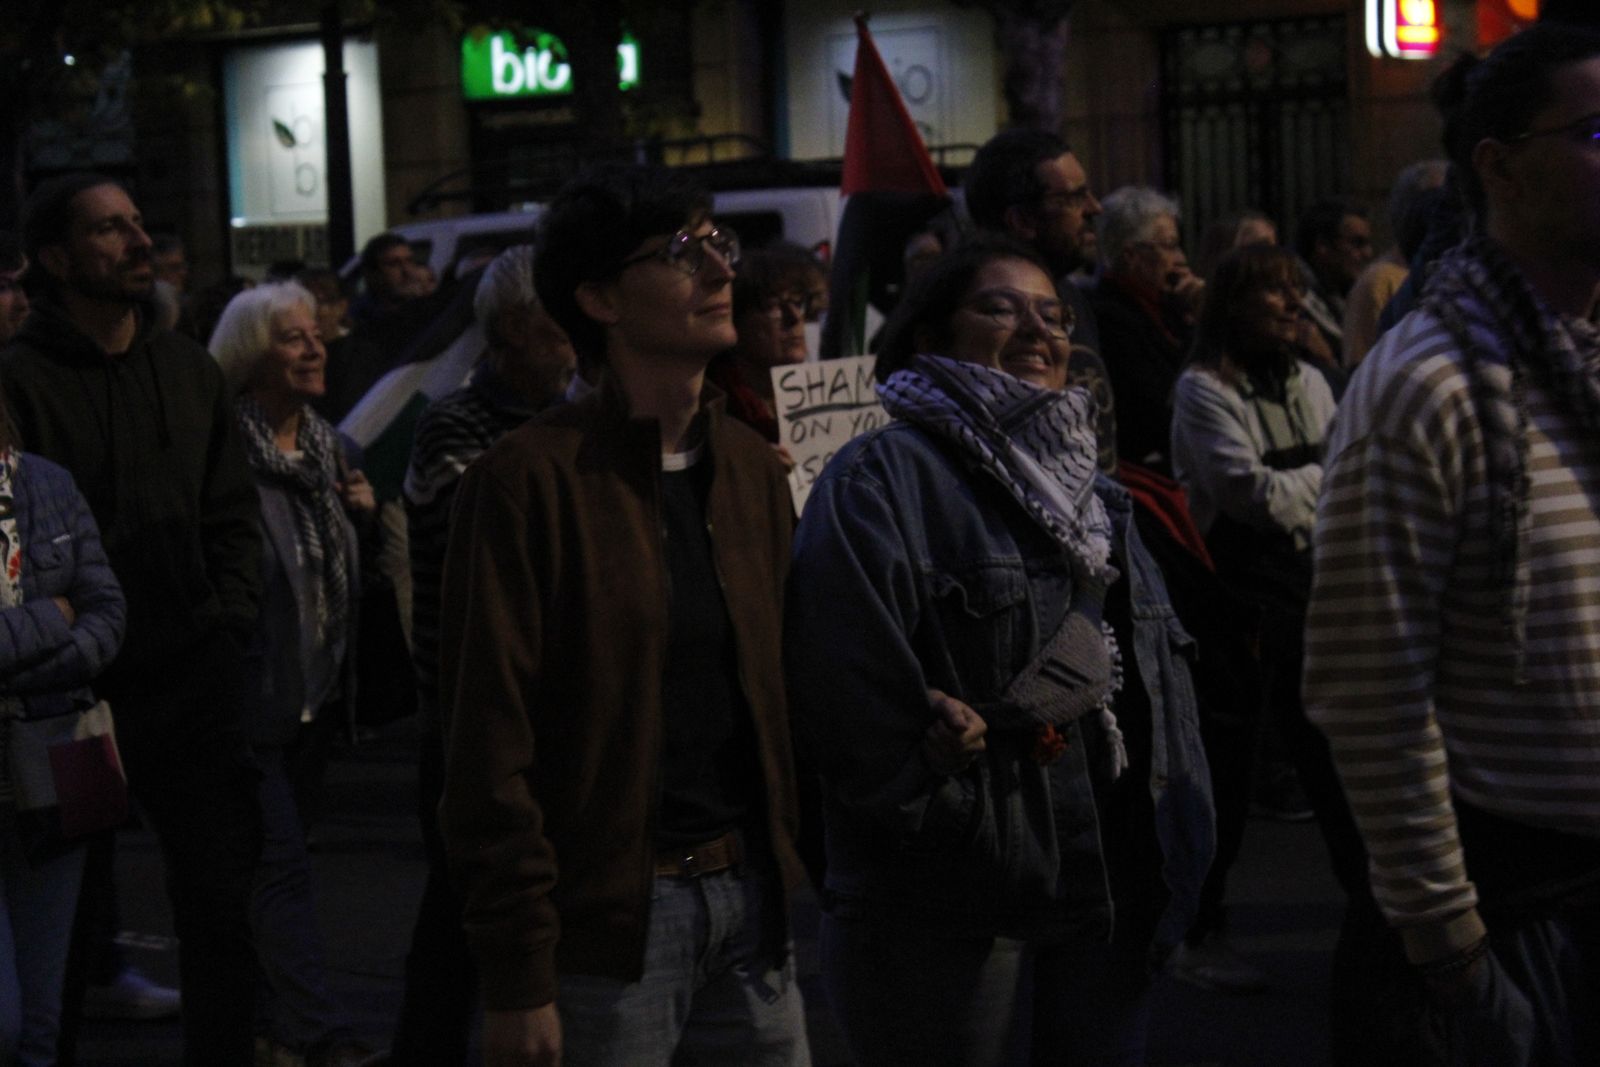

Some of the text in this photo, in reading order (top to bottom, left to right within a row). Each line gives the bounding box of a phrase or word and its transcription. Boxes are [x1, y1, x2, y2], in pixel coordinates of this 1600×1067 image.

[779, 364, 877, 411] SHAM
[790, 411, 887, 444] ON YO
